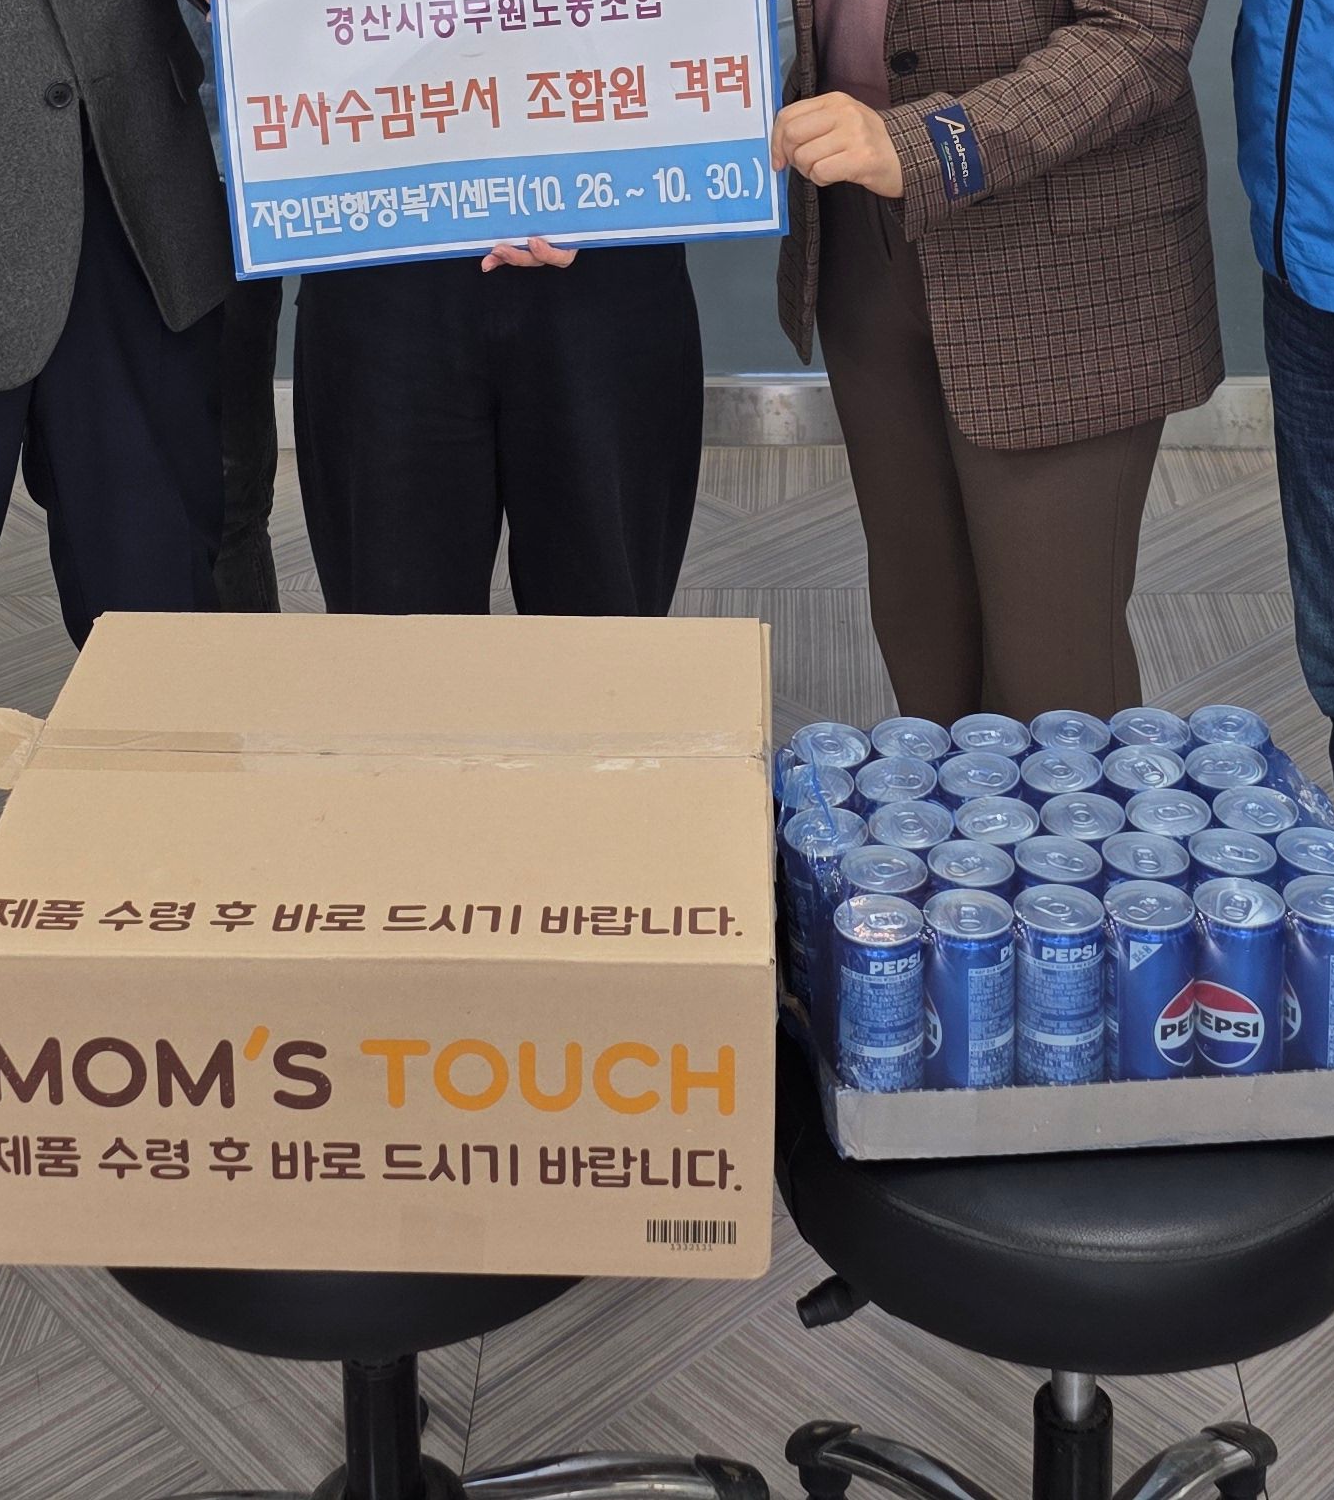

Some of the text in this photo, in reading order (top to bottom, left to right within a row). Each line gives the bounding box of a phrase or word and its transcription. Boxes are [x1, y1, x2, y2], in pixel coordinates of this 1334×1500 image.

[246, 54, 752, 152] 감사수감부서 조합원 격려
[705, 157, 765, 200] 30.)
[98, 900, 195, 932] 수령
[209, 900, 257, 933] 후
[272, 903, 366, 933] 바로
[382, 904, 522, 935] 드시기
[540, 905, 743, 937] 바랍니다.
[869, 950, 921, 976] PEPSI
[1041, 942, 1097, 963] PEPSI
[361, 1039, 735, 1116] TOUCH
[98, 1136, 190, 1180] 수령
[208, 1136, 254, 1182] 후
[271, 1140, 366, 1183] 바로
[382, 1142, 519, 1187] 드시기
[539, 1145, 742, 1192] 바랍니다.
